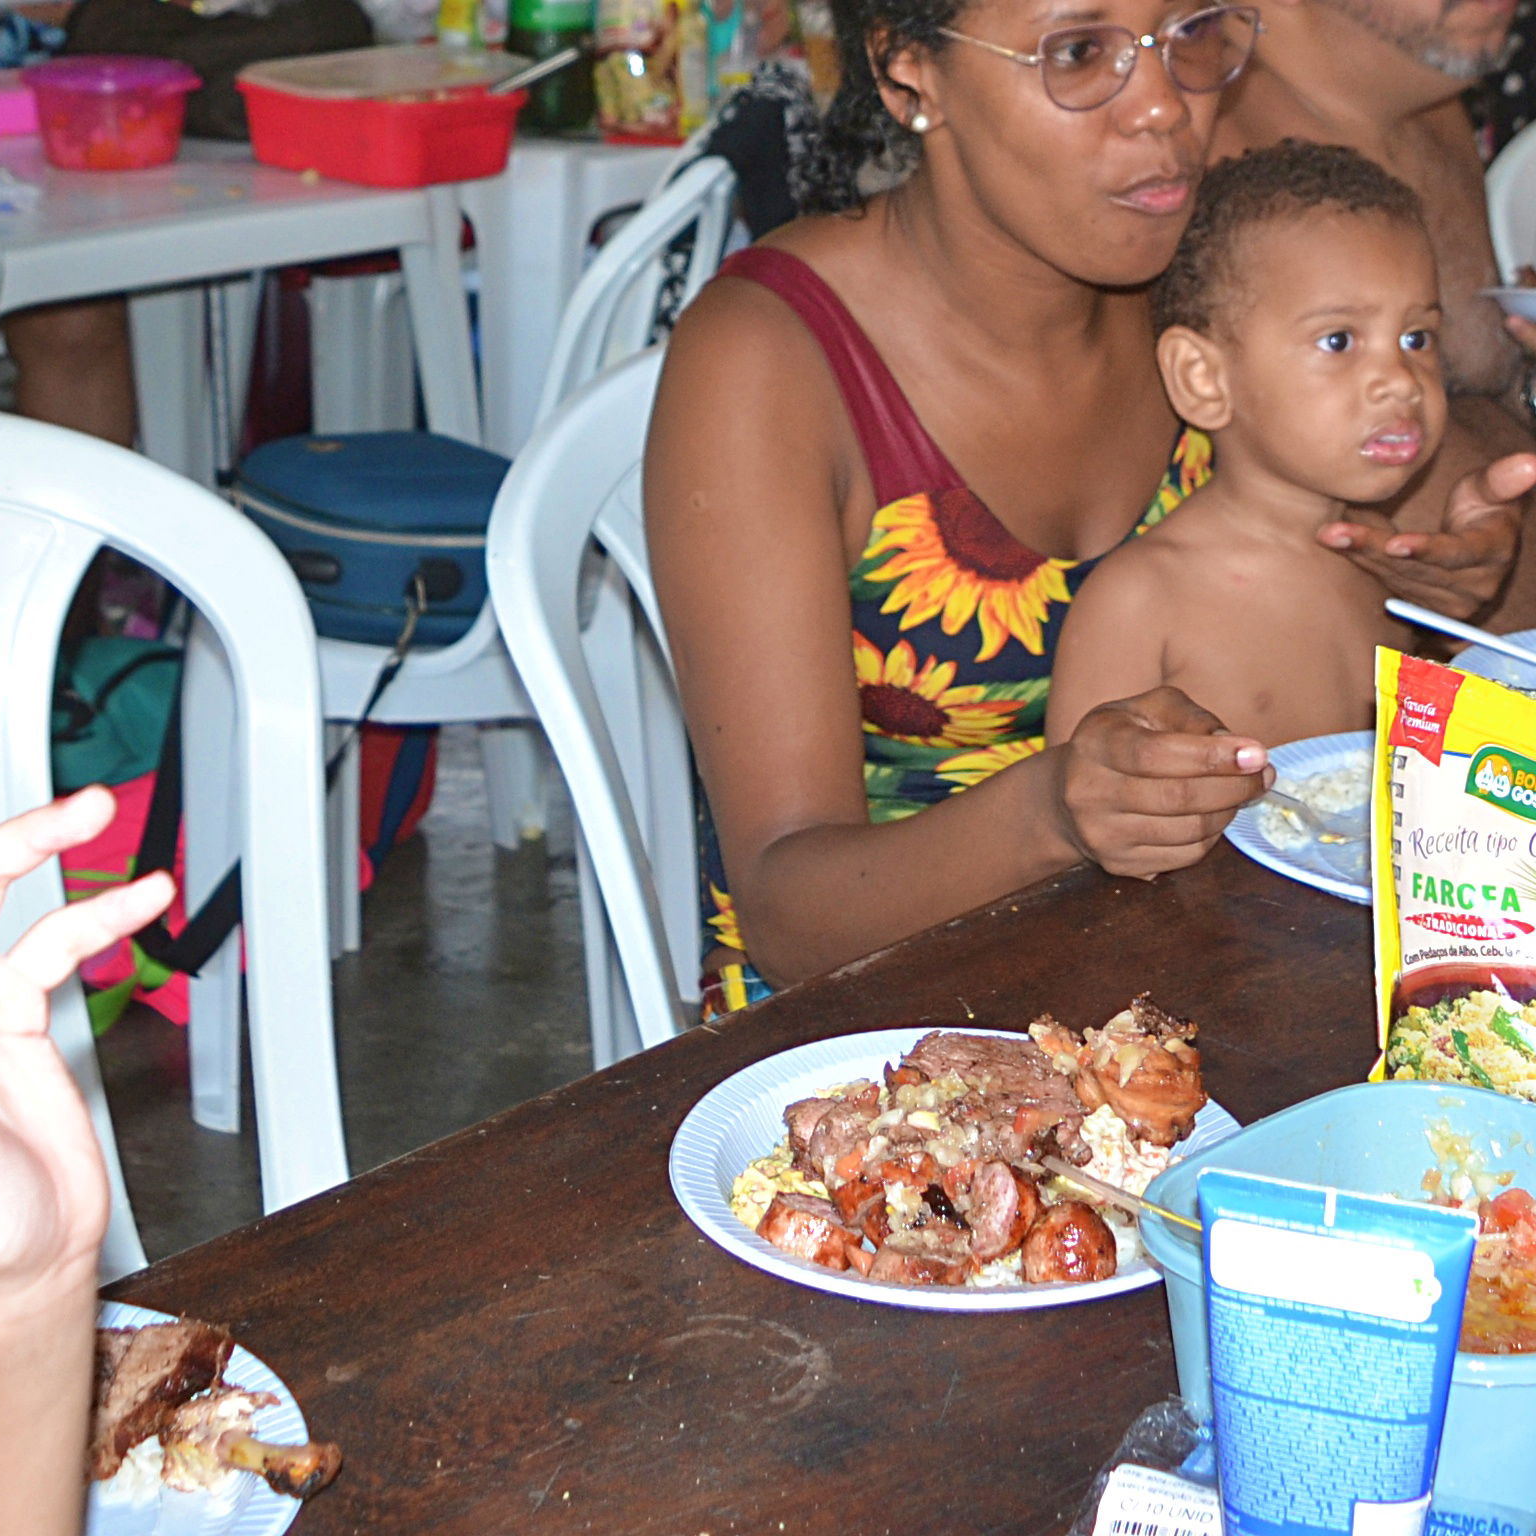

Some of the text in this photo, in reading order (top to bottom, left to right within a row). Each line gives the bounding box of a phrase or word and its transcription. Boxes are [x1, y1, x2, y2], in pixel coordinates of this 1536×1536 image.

[1403, 696, 1437, 719] Farofa
[1408, 825, 1479, 860] Receita
[1486, 831, 1518, 858] tipo
